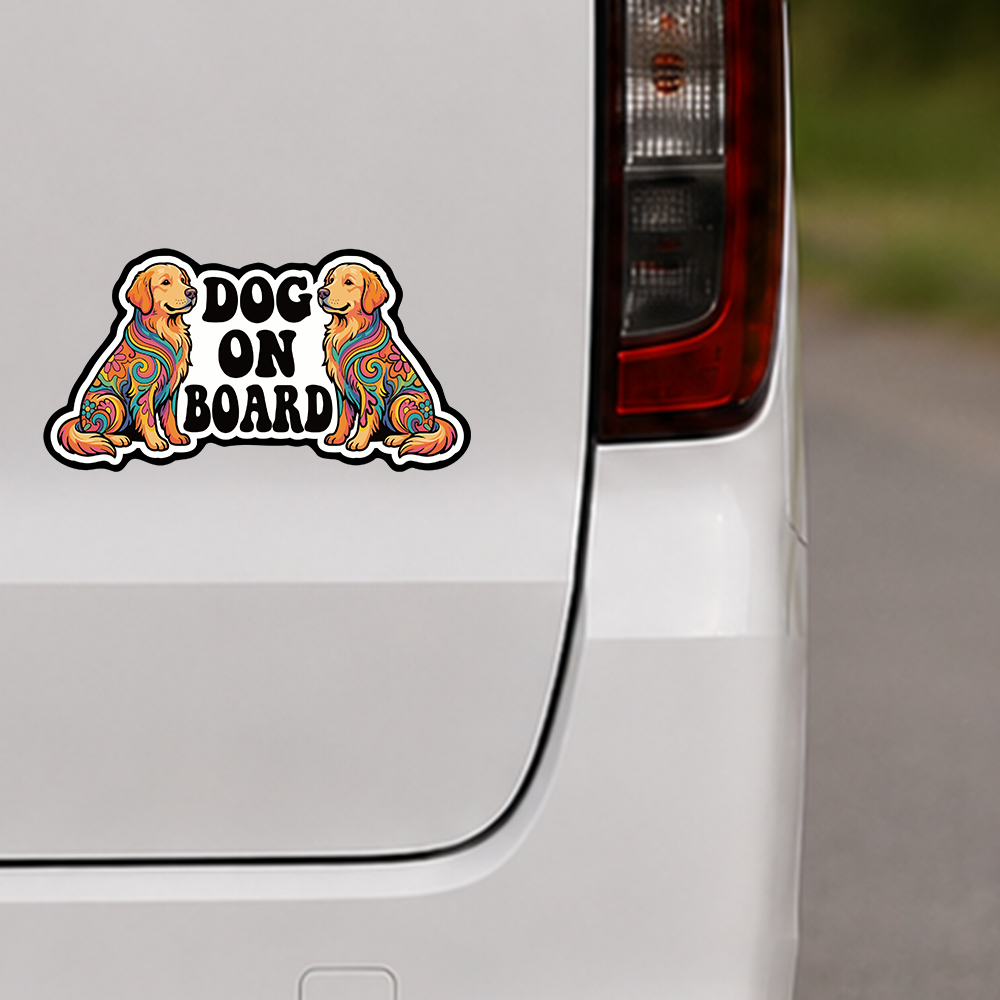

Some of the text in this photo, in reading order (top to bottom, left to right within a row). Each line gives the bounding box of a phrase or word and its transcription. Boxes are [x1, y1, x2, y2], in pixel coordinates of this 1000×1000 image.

[202, 276, 313, 323] DOG
[218, 329, 297, 378] ON
[183, 384, 333, 433] BOARD
